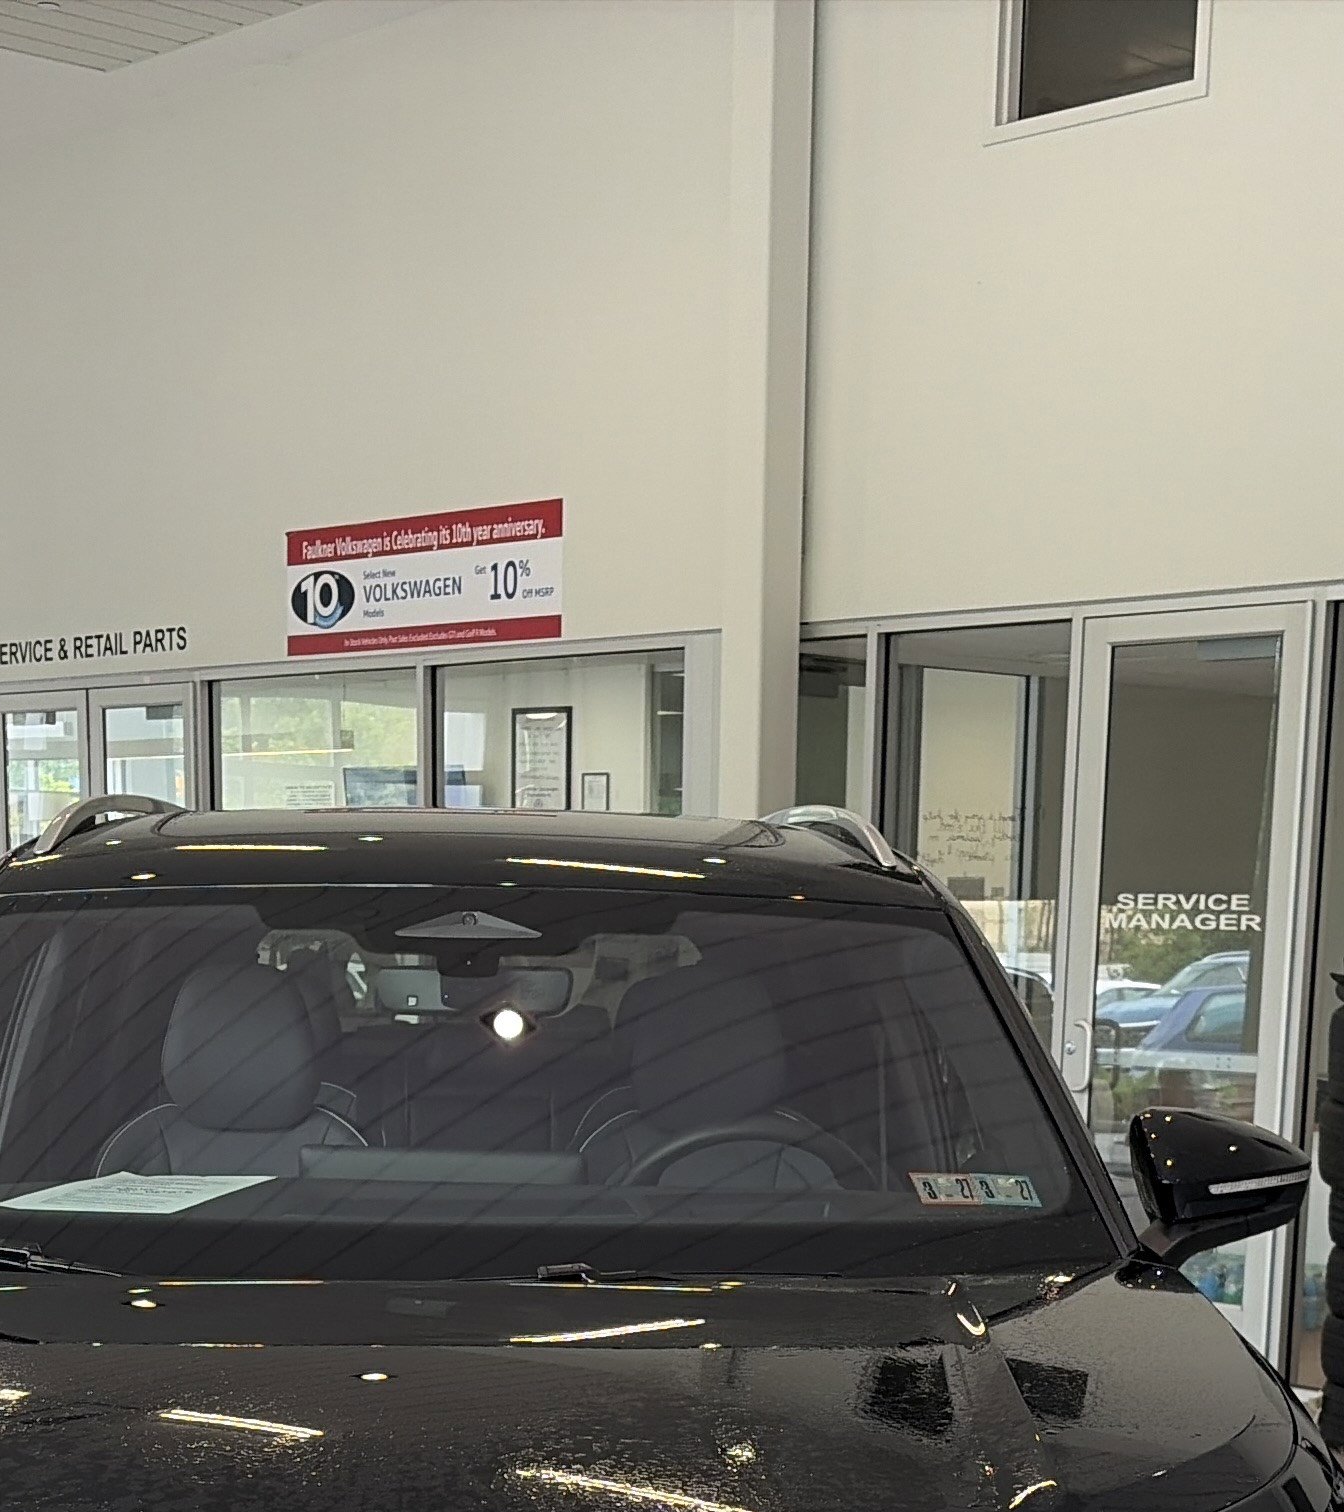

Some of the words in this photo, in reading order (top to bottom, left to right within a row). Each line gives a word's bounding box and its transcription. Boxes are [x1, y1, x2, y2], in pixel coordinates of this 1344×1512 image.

[302, 540, 335, 560] Faulkner
[335, 536, 382, 557] Volkswagen
[383, 532, 391, 551] is
[392, 527, 438, 551] Celebrating
[451, 521, 472, 544] 10th
[472, 525, 491, 546] year
[492, 516, 545, 539] anniversary.
[362, 575, 463, 604] VOLKSWAGEN
[57, 637, 69, 660] &
[73, 632, 129, 659] RETAIL
[132, 626, 188, 655] PARTS
[1116, 893, 1251, 911] SERVICE
[1103, 913, 1263, 931] MANAGER
